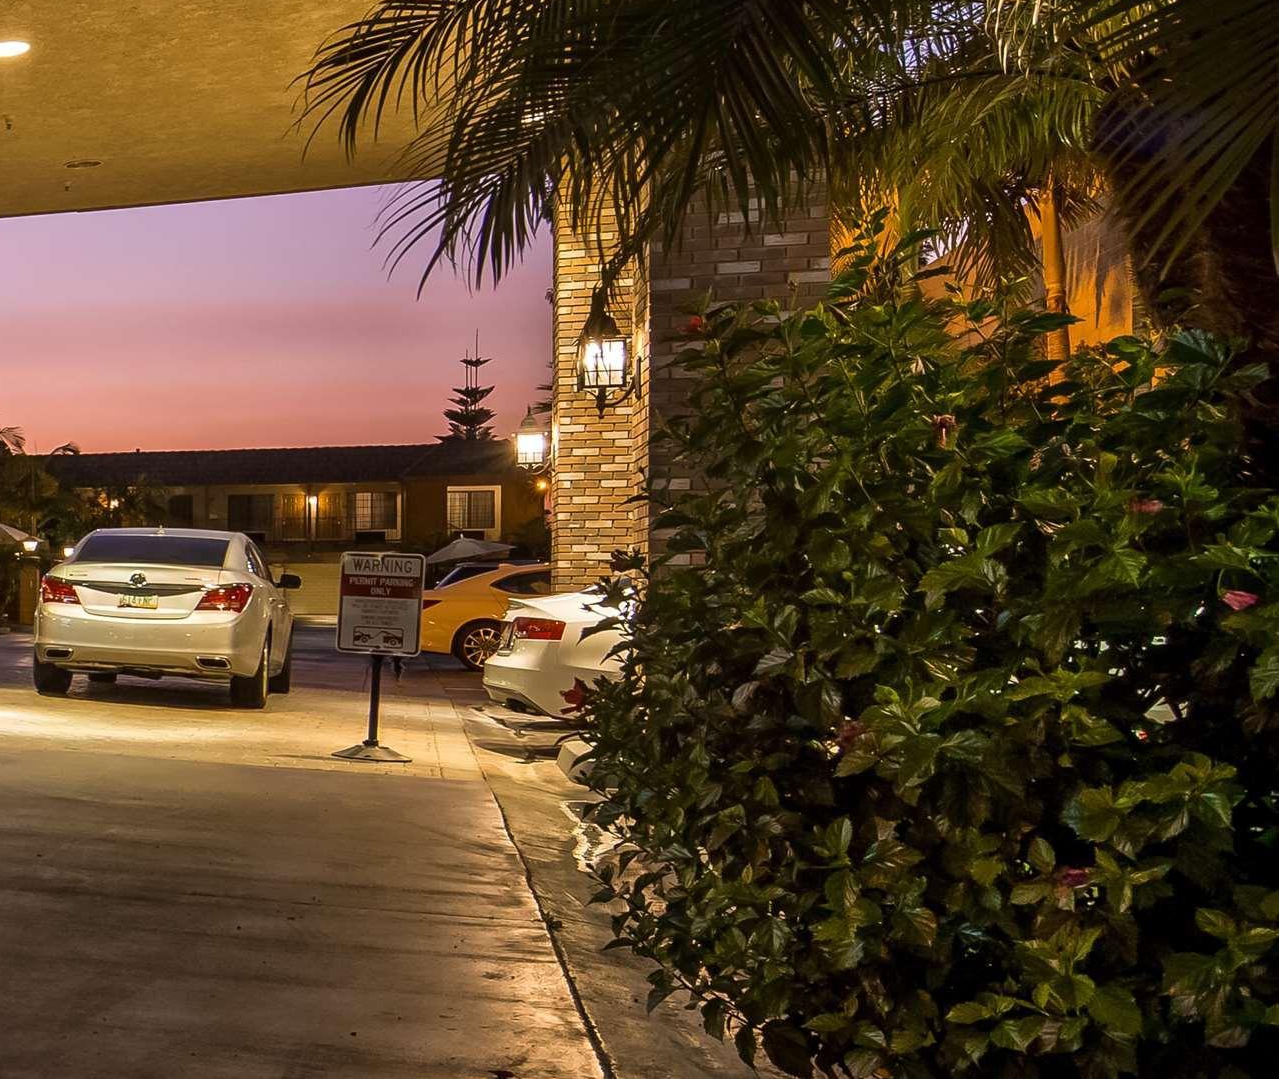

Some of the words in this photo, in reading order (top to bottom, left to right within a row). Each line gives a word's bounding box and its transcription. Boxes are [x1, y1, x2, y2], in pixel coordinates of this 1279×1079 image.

[353, 558, 413, 573] WARNING
[349, 576, 378, 586] PERMIT
[379, 577, 414, 588] PARKING
[370, 587, 392, 596] ONLY
